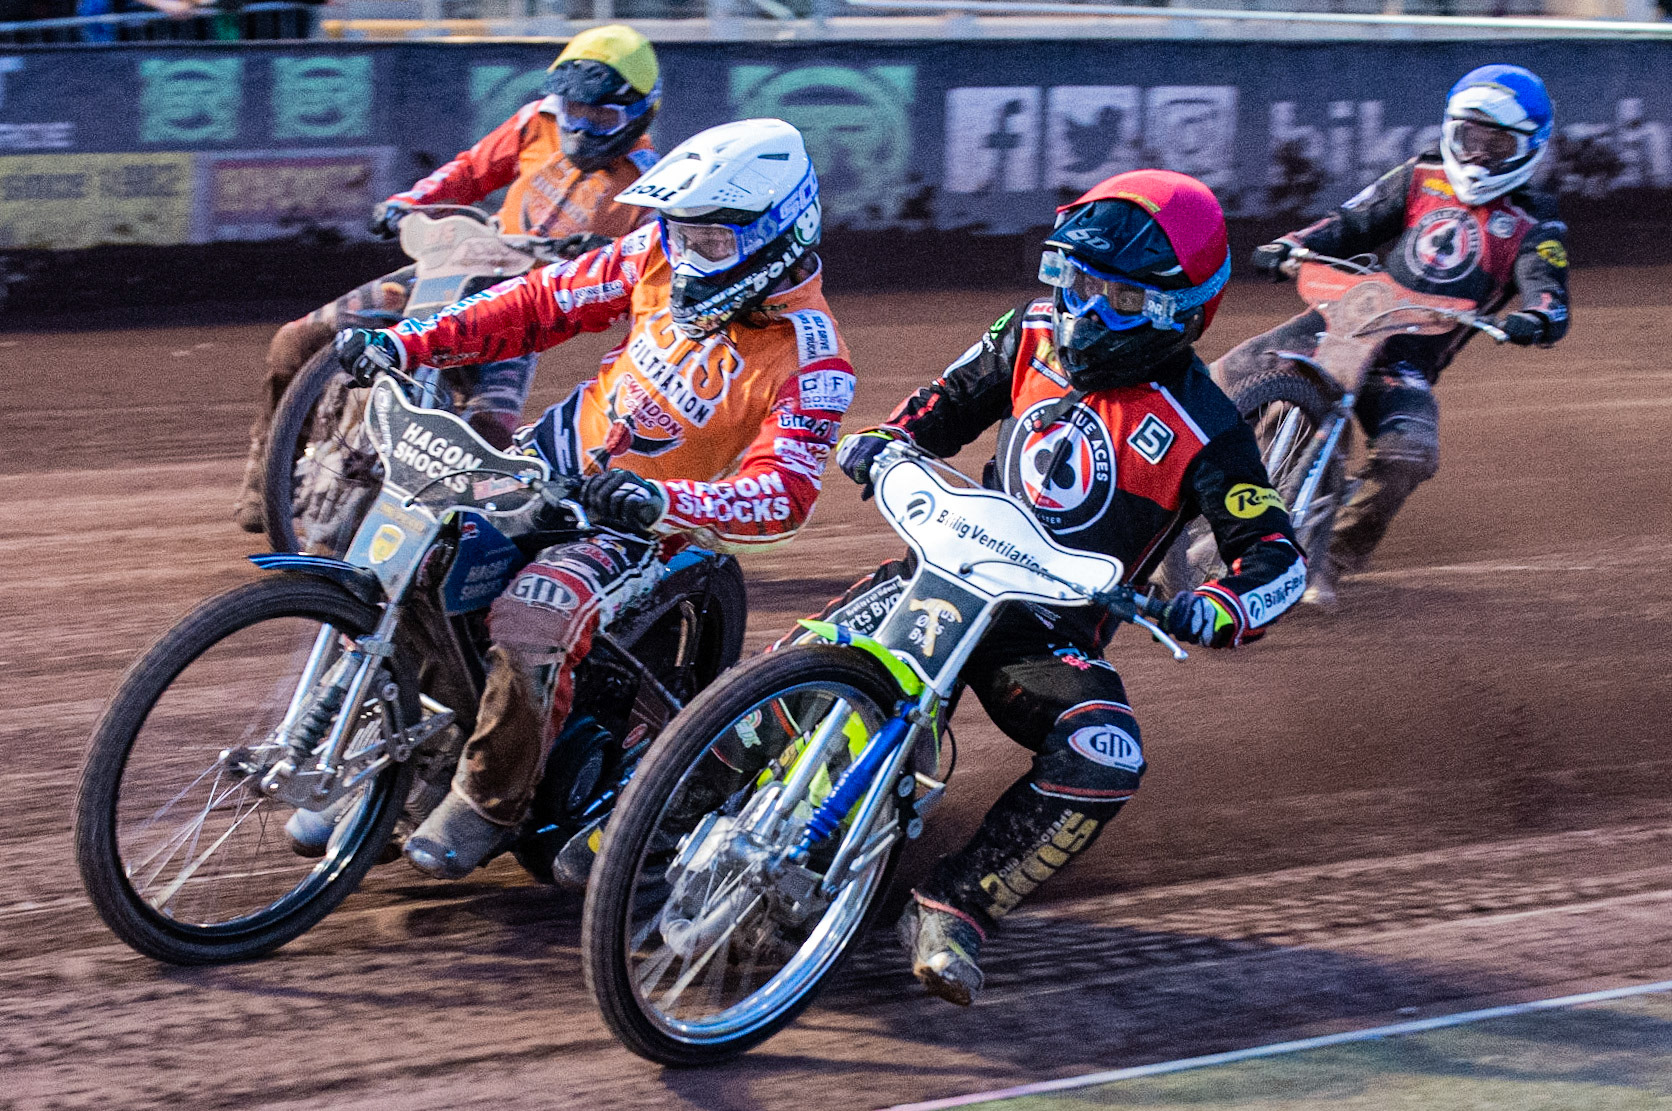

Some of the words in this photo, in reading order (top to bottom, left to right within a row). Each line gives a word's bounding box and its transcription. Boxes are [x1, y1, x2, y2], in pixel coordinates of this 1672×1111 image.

[623, 372, 683, 437] SWINDON
[630, 338, 710, 424] FILTRATION
[401, 421, 483, 471] HAGON
[1090, 439, 1110, 482] ACES
[1145, 425, 1165, 454] 5
[392, 440, 470, 494] SHOCKS
[675, 492, 791, 524] SHOCKS
